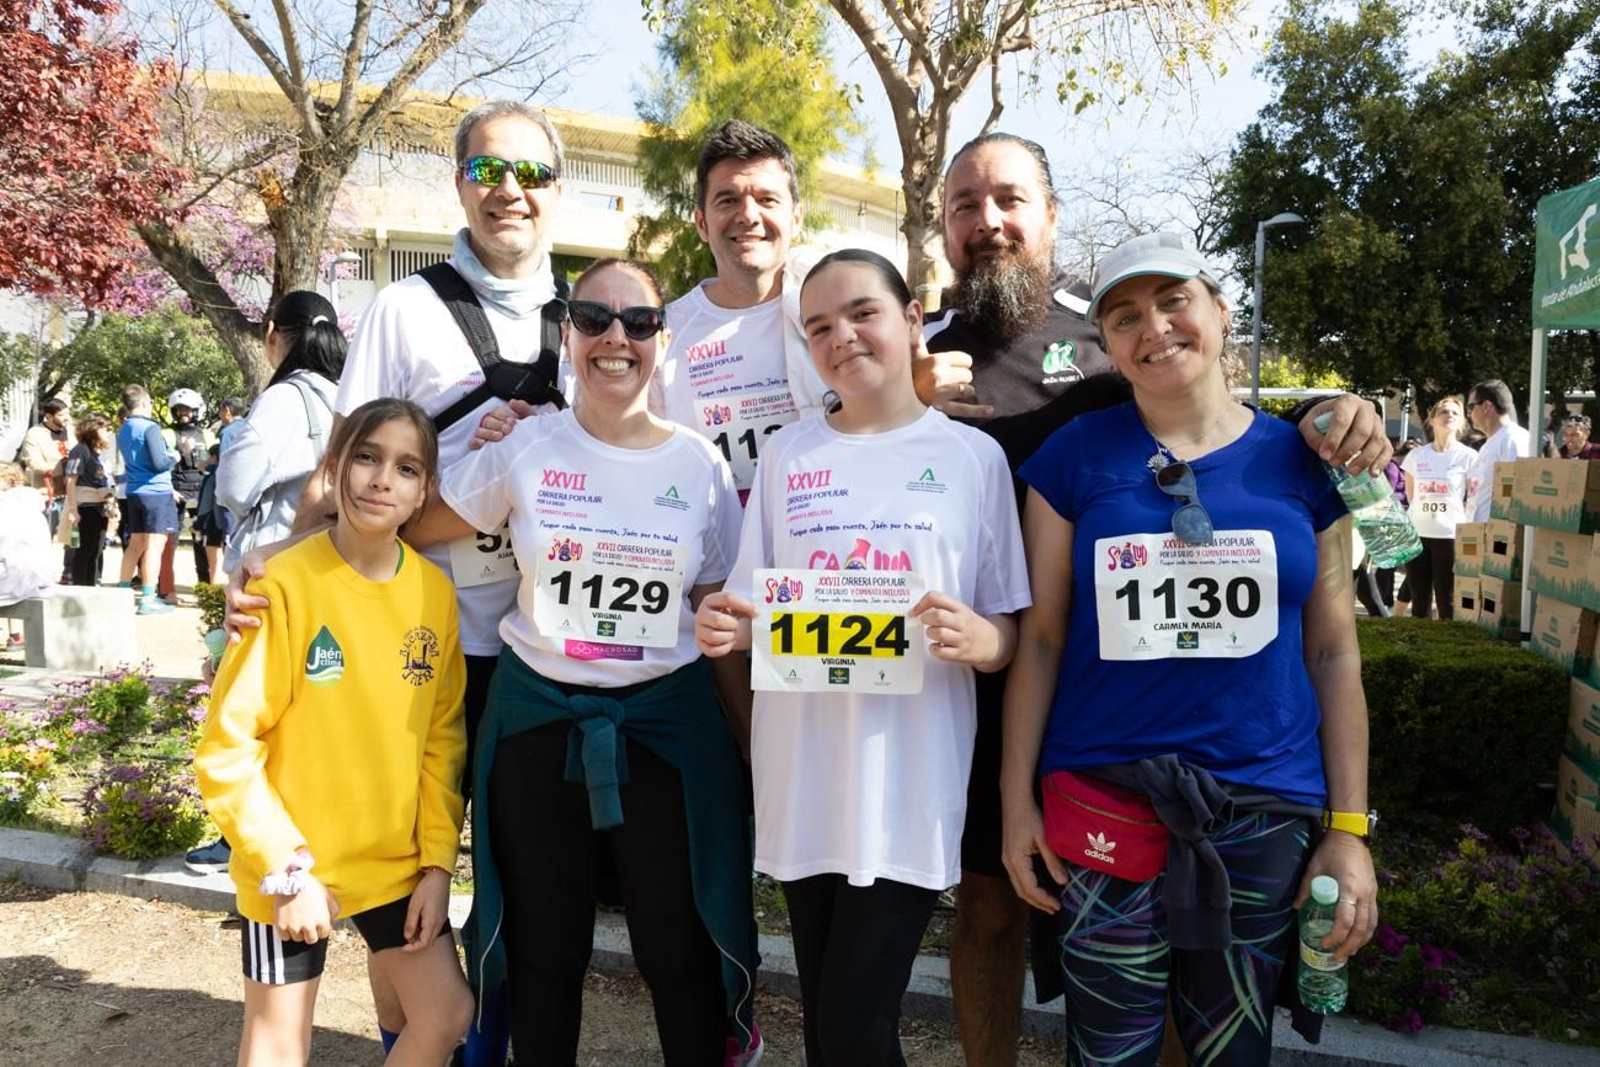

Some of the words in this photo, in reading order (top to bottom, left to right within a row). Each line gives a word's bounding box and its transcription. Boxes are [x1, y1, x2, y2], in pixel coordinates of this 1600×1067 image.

[687, 340, 728, 363] XXVII
[541, 469, 587, 491] XXVII
[787, 469, 833, 493] XXVII
[538, 490, 567, 500] CARRERA
[569, 494, 603, 503] POPULAR
[813, 488, 849, 500] POPULAR
[1422, 502, 1447, 513] 803
[809, 523, 823, 533] cada
[915, 521, 932, 532] salud
[663, 534, 678, 543] salud
[1220, 537, 1255, 547] POPULAR
[617, 544, 643, 553] CARRERA
[644, 547, 673, 557] POPULAR
[819, 577, 840, 586] XXVII
[841, 576, 872, 586] CARRERA
[873, 577, 906, 586] POPULAR
[550, 570, 670, 615] 1129
[1115, 576, 1261, 621] 1130
[592, 611, 622, 620] VIRGINIA
[1153, 622, 1188, 631] CARMEN
[1191, 620, 1222, 630] MARÍA
[770, 613, 910, 656] 1124
[306, 646, 342, 670] Jaén
[820, 658, 856, 666] VIRGINIA
[1084, 849, 1115, 865] adidas
